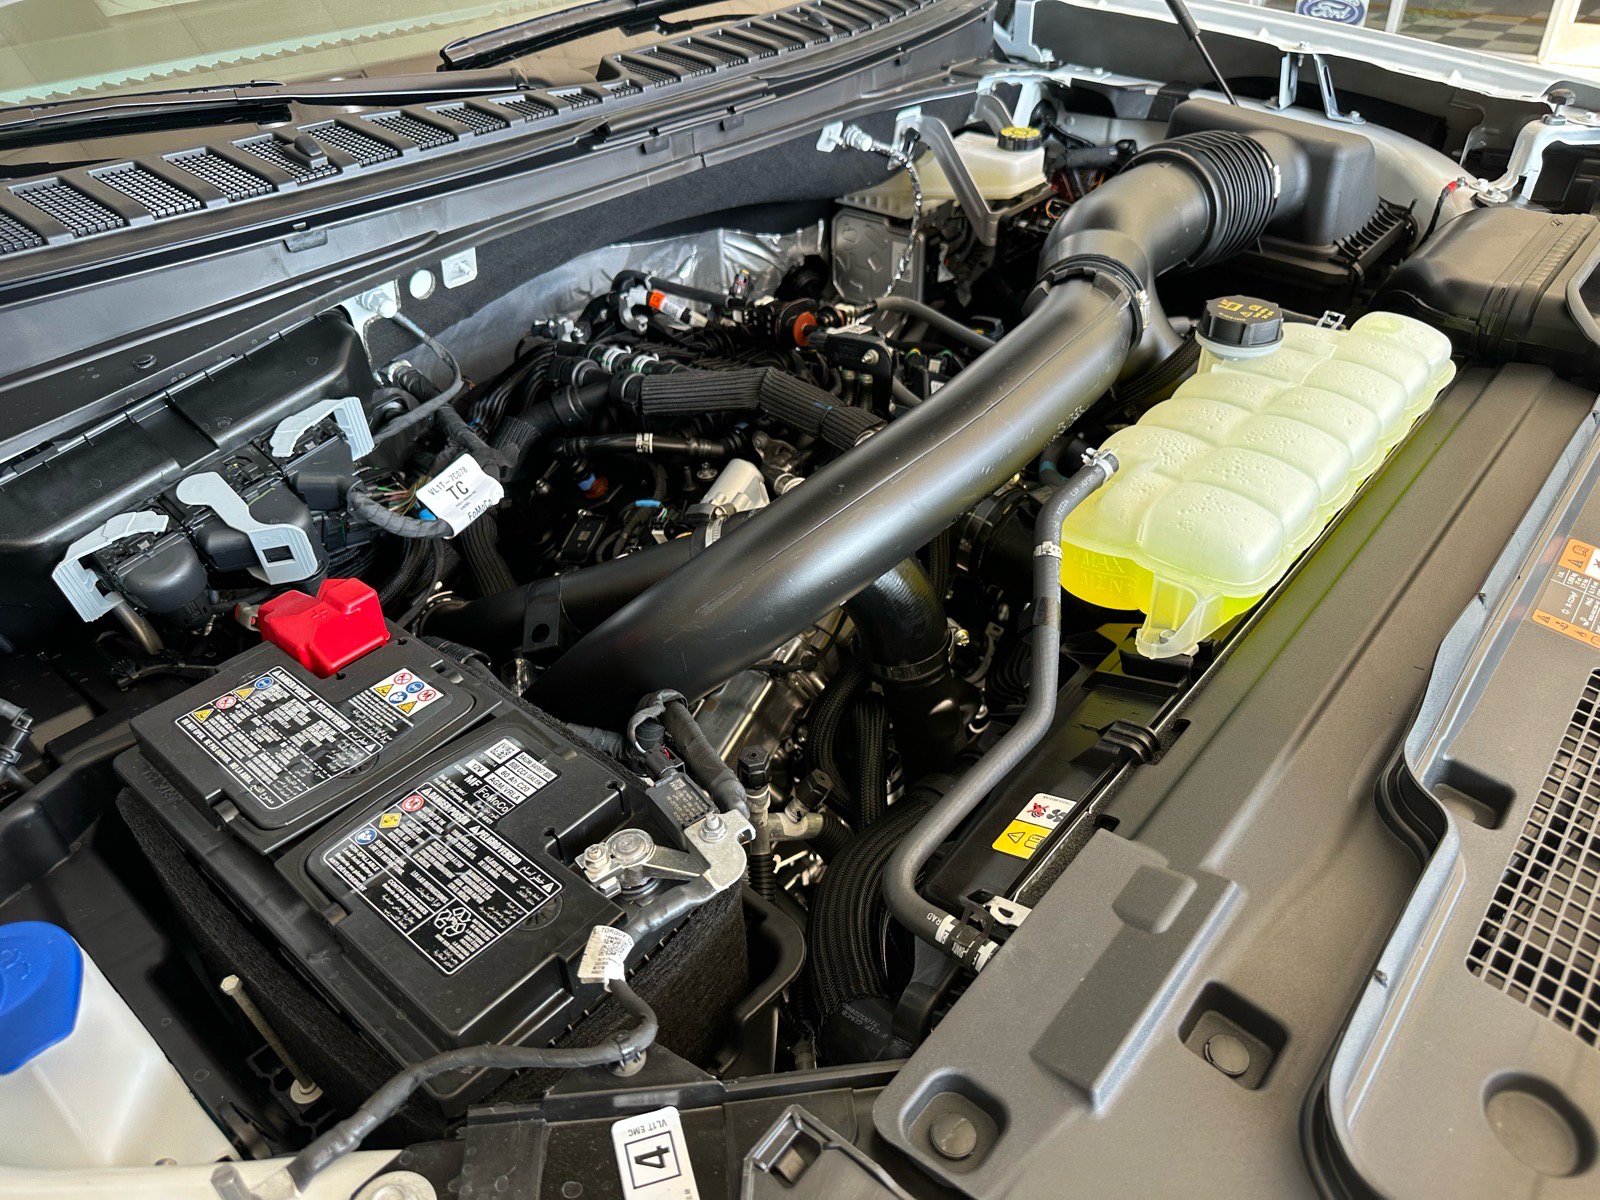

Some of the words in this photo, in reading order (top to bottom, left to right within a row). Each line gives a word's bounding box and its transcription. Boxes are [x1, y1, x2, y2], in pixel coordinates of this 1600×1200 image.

[1310, 1, 1351, 19] Ford
[446, 480, 469, 500] TC
[467, 498, 493, 521] FoMoCo
[1080, 551, 1125, 574] MAX
[1081, 570, 1124, 593] MIN
[470, 762, 484, 772] 12V
[462, 774, 483, 788] MF
[506, 775, 520, 784] Ah
[515, 781, 530, 792] C20
[476, 787, 512, 813] FoMoCo
[426, 791, 471, 825] DANGER/POISON
[475, 829, 522, 866] PELIGRO/VENENO
[386, 878, 406, 895] CONTRA
[403, 892, 429, 915] DERRAMES
[926, 912, 943, 926] RAD
[628, 1125, 646, 1137] EMC
[648, 1118, 668, 1132] VL1T
[633, 1144, 670, 1169] 4
